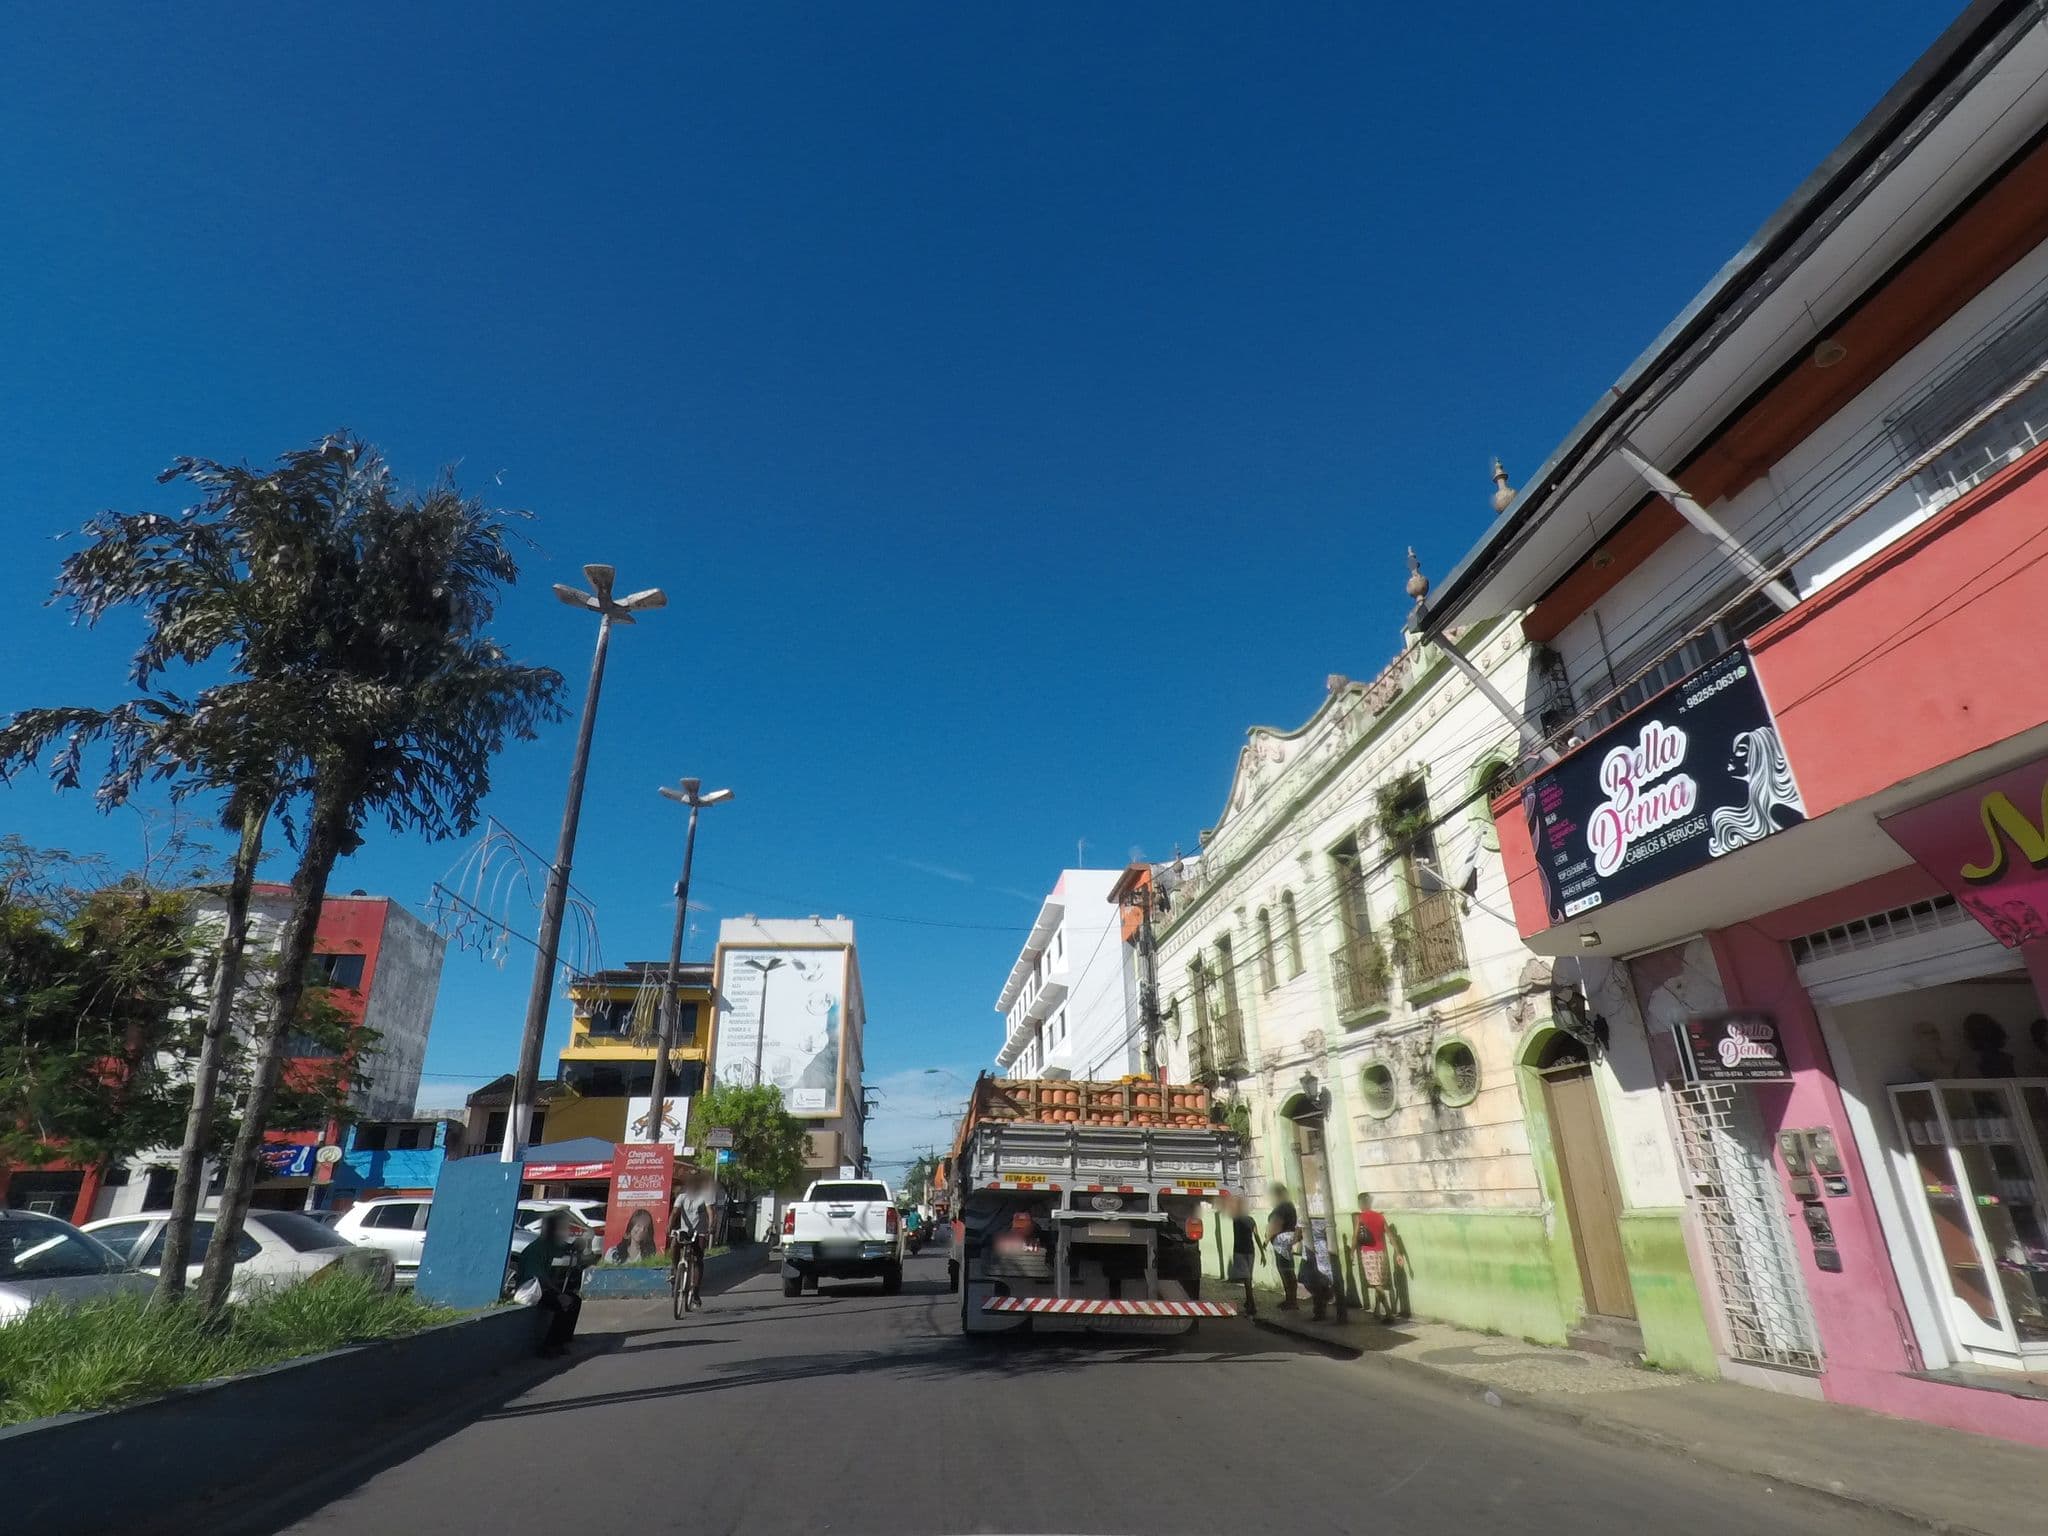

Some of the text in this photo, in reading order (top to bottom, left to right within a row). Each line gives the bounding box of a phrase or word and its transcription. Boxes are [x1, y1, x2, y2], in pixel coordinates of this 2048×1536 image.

[1686, 669, 1739, 708] 98255-0631
[1603, 725, 1683, 813] Bella
[1590, 778, 1692, 871] Donna
[1626, 818, 1706, 863] CABELOS & PERUCAS
[628, 1151, 656, 1161] Chegou
